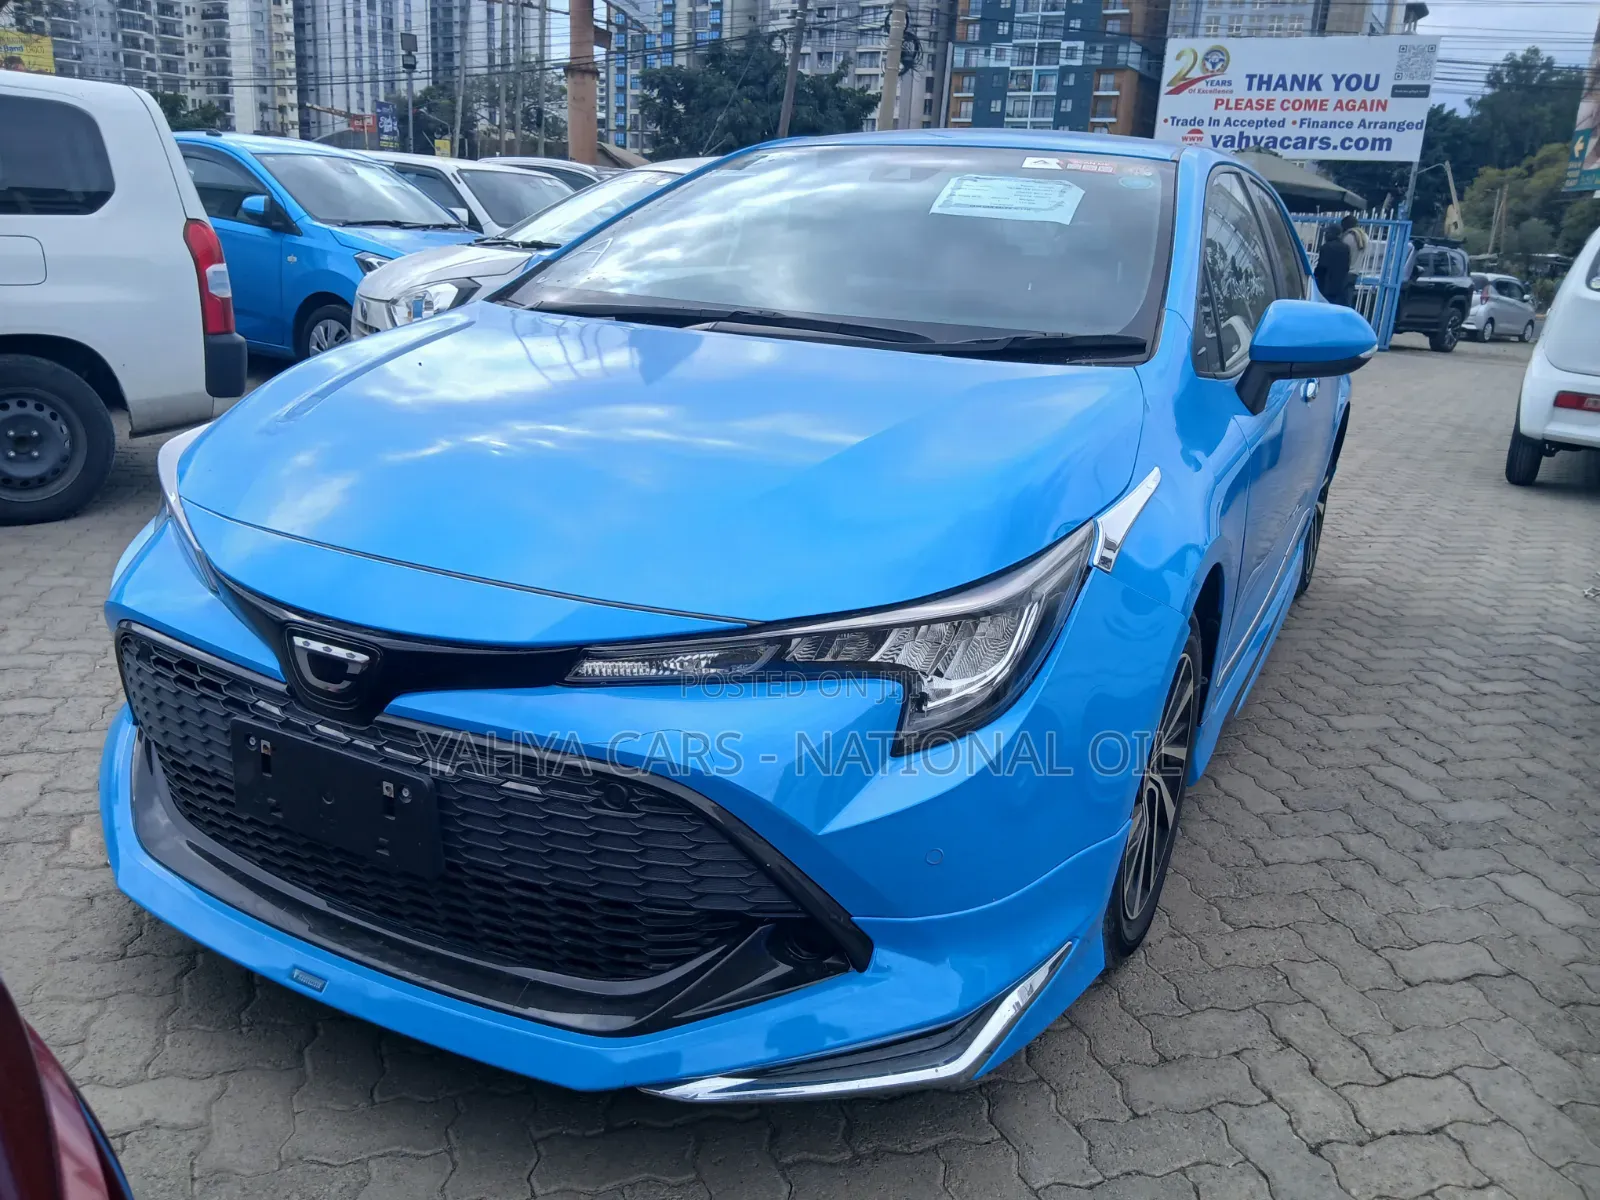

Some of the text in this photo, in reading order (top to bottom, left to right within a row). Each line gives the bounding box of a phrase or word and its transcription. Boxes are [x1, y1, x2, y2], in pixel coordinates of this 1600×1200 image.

[1205, 79, 1233, 87] YEARS
[1245, 73, 1381, 92] THANK YOU
[1214, 98, 1389, 112] PLEASE COME AGAIN
[1170, 116, 1425, 132] Trade In Accepted Finance Arranged
